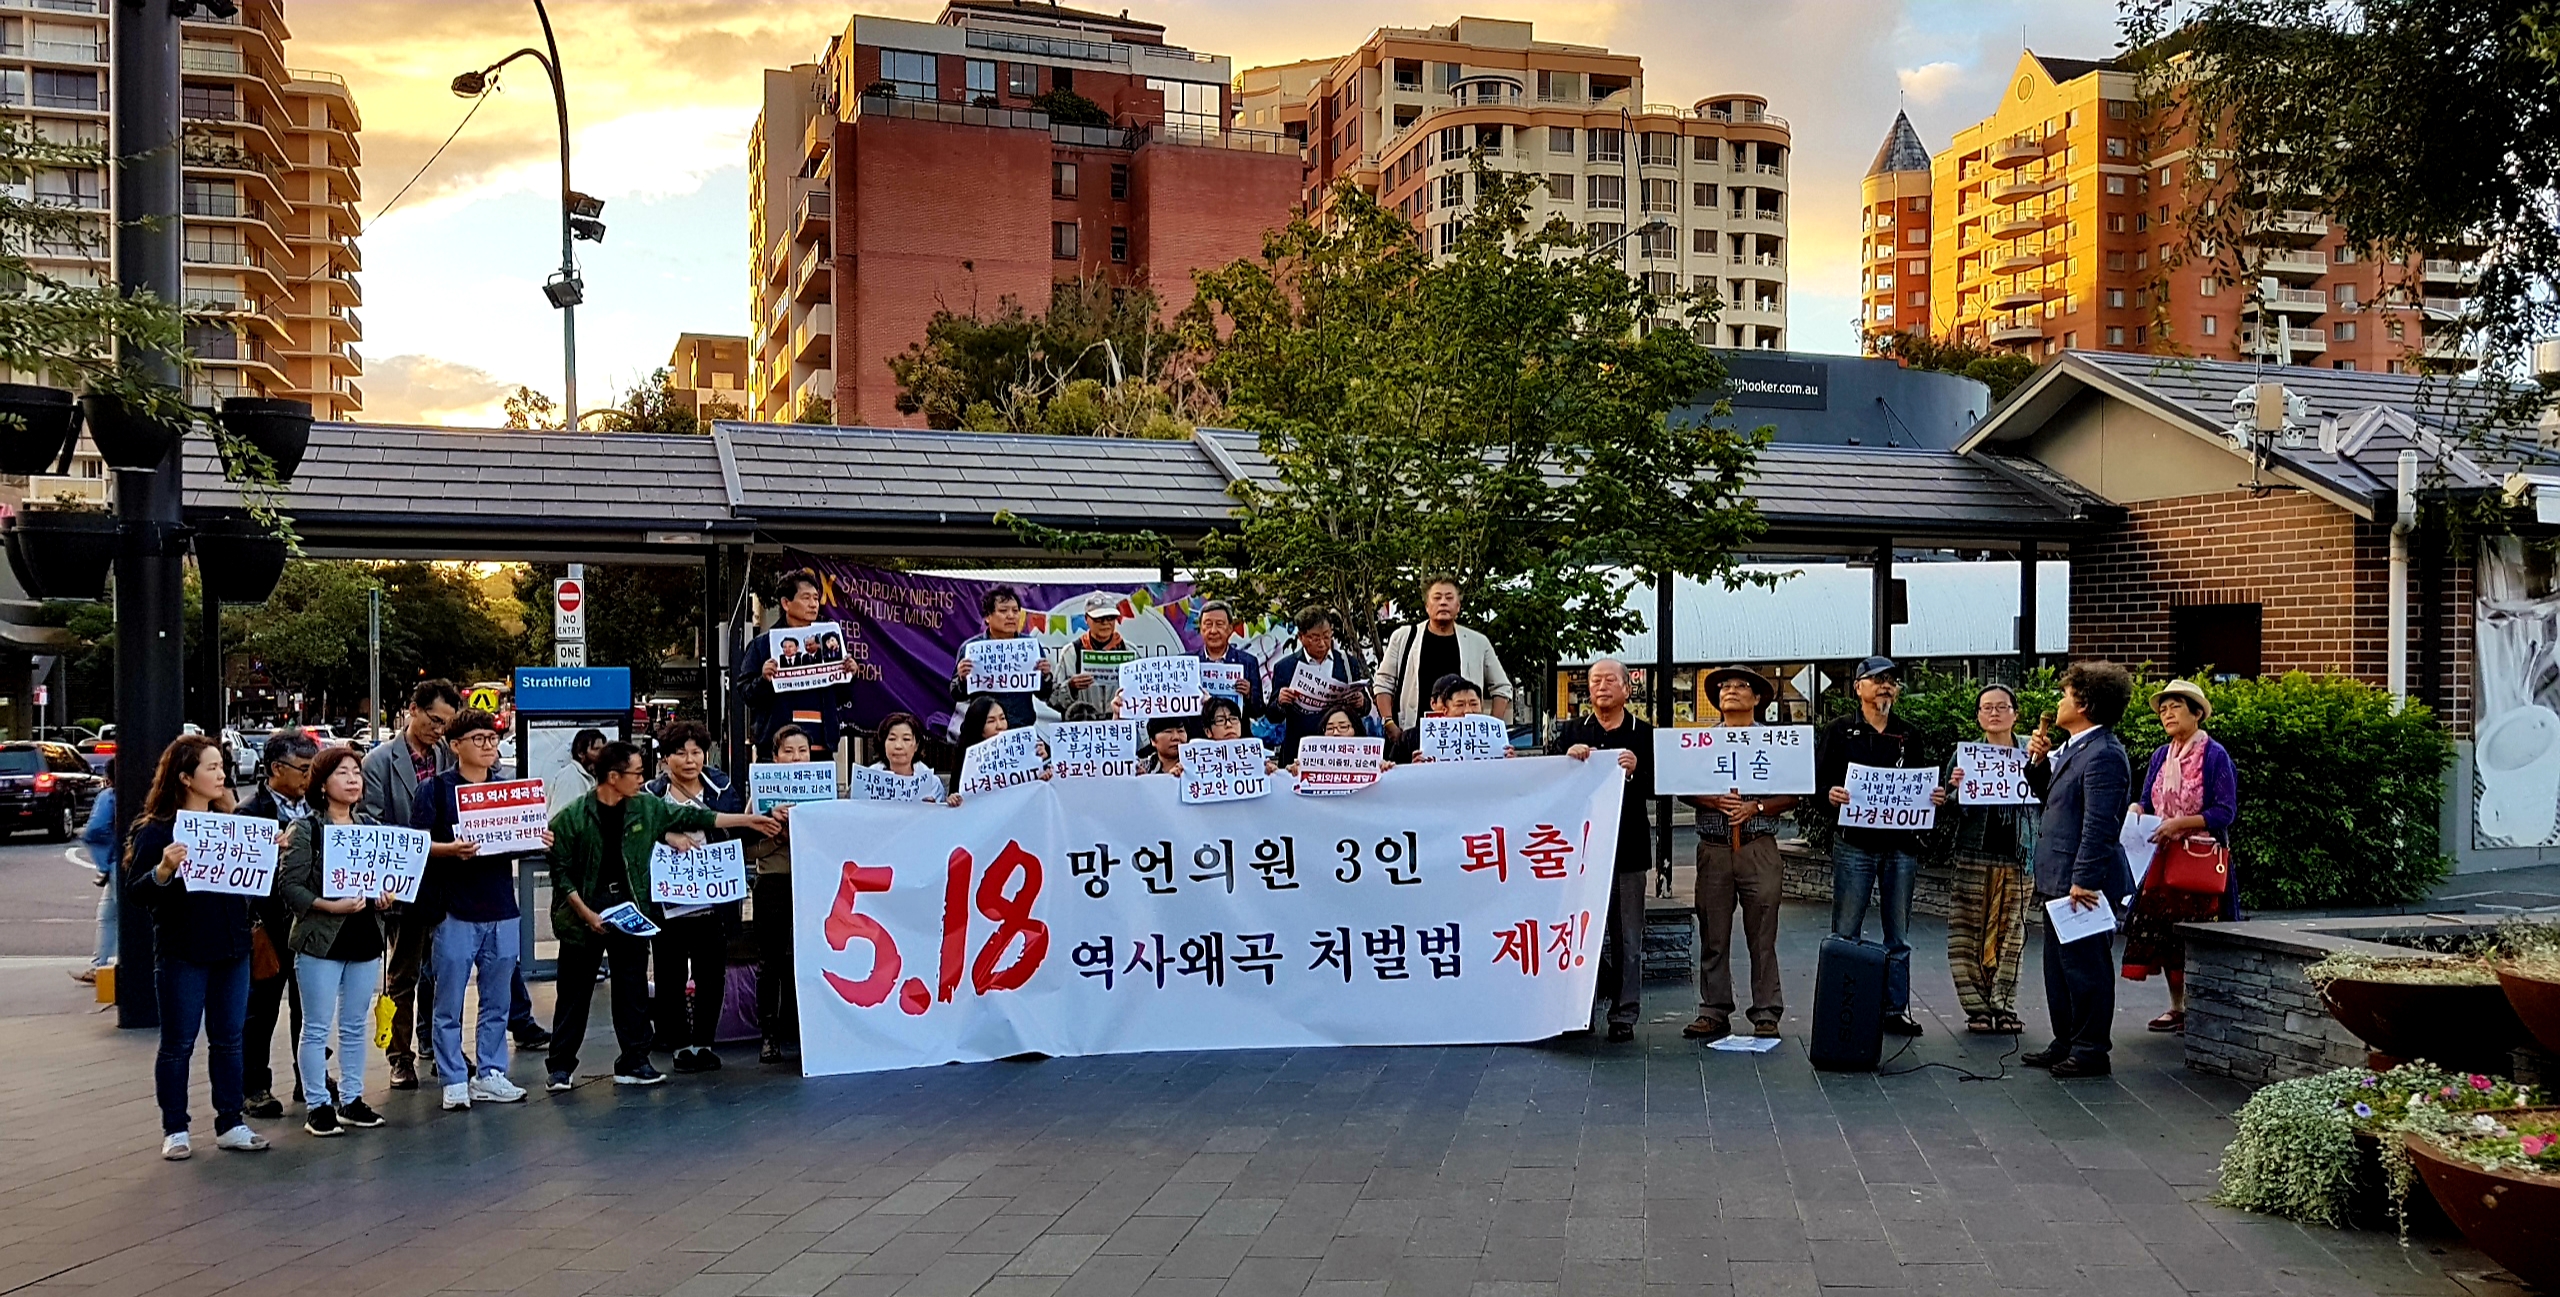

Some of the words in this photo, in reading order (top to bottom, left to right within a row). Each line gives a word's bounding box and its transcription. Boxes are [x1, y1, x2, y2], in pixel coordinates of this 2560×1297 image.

[842, 576, 907, 603] SATURDAY
[909, 587, 954, 610] NIGHTS
[562, 615, 576, 624] NO
[843, 598, 873, 618] WITH
[876, 601, 901, 623] LIVE
[904, 607, 943, 629] MUSIC
[558, 626, 581, 635] ENTRY
[840, 619, 861, 639] FEB
[560, 647, 581, 658] ONE
[847, 641, 869, 660] FEB
[829, 671, 848, 683] OUT
[857, 663, 883, 682] RCH
[1123, 663, 1148, 676] 5.18
[1299, 669, 1314, 680] 5.18
[522, 676, 591, 688] Strathfield
[970, 675, 1008, 689] 나경원
[1010, 674, 1037, 688] OUT
[1125, 697, 1168, 716] 나경원
[1170, 695, 1200, 713] OUT
[1055, 723, 1133, 743] 촛불시민혁명
[1425, 721, 1502, 738] 촛불시민혁명
[1681, 732, 1713, 748] 5.18
[1726, 731, 1751, 746] 모독
[1762, 730, 1800, 746] 의원들
[1067, 743, 1121, 759] 부정하는
[1184, 746, 1228, 764] 박근혜
[1234, 744, 1263, 760] 탄핵
[1301, 744, 1318, 753] 5.18
[1320, 743, 1336, 754] 역사
[1436, 739, 1491, 755] 부정하는
[754, 771, 771, 780] 5.18
[774, 771, 790, 780] 역사
[856, 772, 880, 785] 5.18
[1055, 760, 1097, 778] 황교안
[1102, 760, 1134, 776] OUT
[1195, 761, 1254, 779] 부정하는
[1851, 768, 1879, 782] 5.18
[1884, 772, 1908, 783] 역사
[1974, 760, 2024, 778] 부정하
[965, 772, 1007, 794] 나경원
[1010, 768, 1040, 786] OUT
[1188, 780, 1228, 799] 황교안
[1234, 778, 1265, 795] OUT
[1965, 779, 2011, 799] 황교안
[461, 791, 485, 804] 5.18
[486, 788, 508, 802] 역사
[510, 786, 530, 800] 왜곡
[1866, 794, 1914, 806] 반대하는
[1846, 806, 1894, 825] 나경원
[1897, 808, 1930, 826] OUT
[184, 817, 236, 841] 박근혜
[243, 823, 273, 845] 탄핵
[195, 839, 262, 863] 부정하는
[330, 829, 425, 854] 촛불시민혁명
[346, 849, 409, 871] 부정하는
[1067, 833, 1301, 901] 망언의원
[1335, 830, 1423, 888] 3인
[1460, 819, 1589, 886] 퇴출!
[229, 867, 268, 889] OUT
[331, 868, 376, 891] 황교안
[382, 874, 415, 895] OUT
[668, 863, 725, 881] 부정하는
[657, 880, 700, 899] 황교안
[706, 879, 739, 898] OUT
[821, 838, 1051, 1016] 5.18
[1070, 931, 1284, 994] 역사왜곡
[1309, 921, 1462, 984] 처벌법
[1491, 911, 1593, 977] 제정!
[1838, 973, 1857, 1042] SONY
